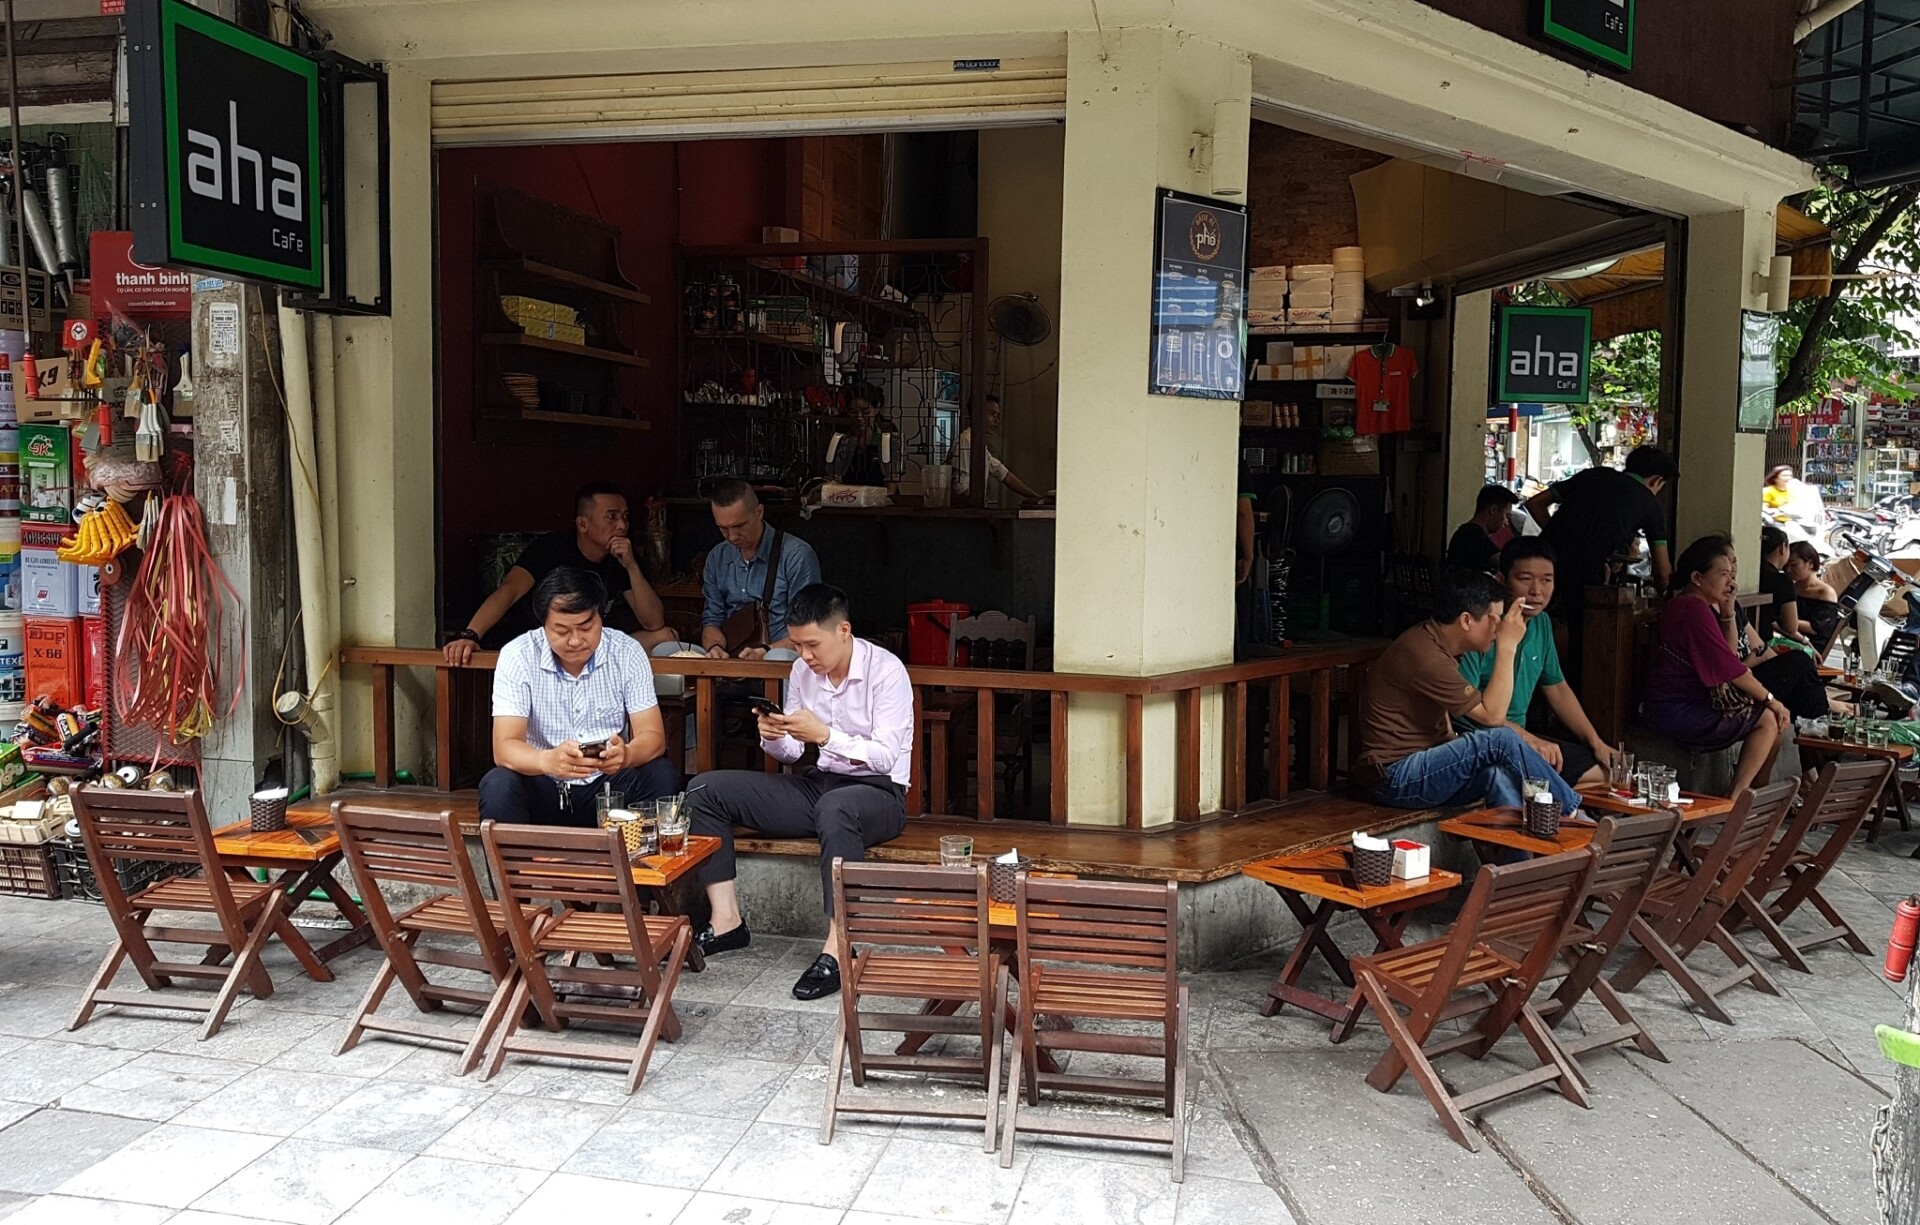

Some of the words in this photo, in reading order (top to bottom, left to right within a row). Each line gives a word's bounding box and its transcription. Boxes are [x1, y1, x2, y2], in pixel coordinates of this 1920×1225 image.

[188, 100, 303, 222] aha
[273, 228, 304, 253] Cafe
[115, 272, 156, 285] thanh
[159, 272, 190, 285] bình
[1510, 334, 1578, 377] aha
[1556, 380, 1577, 389] Cafe
[33, 648, 62, 659] X-66
